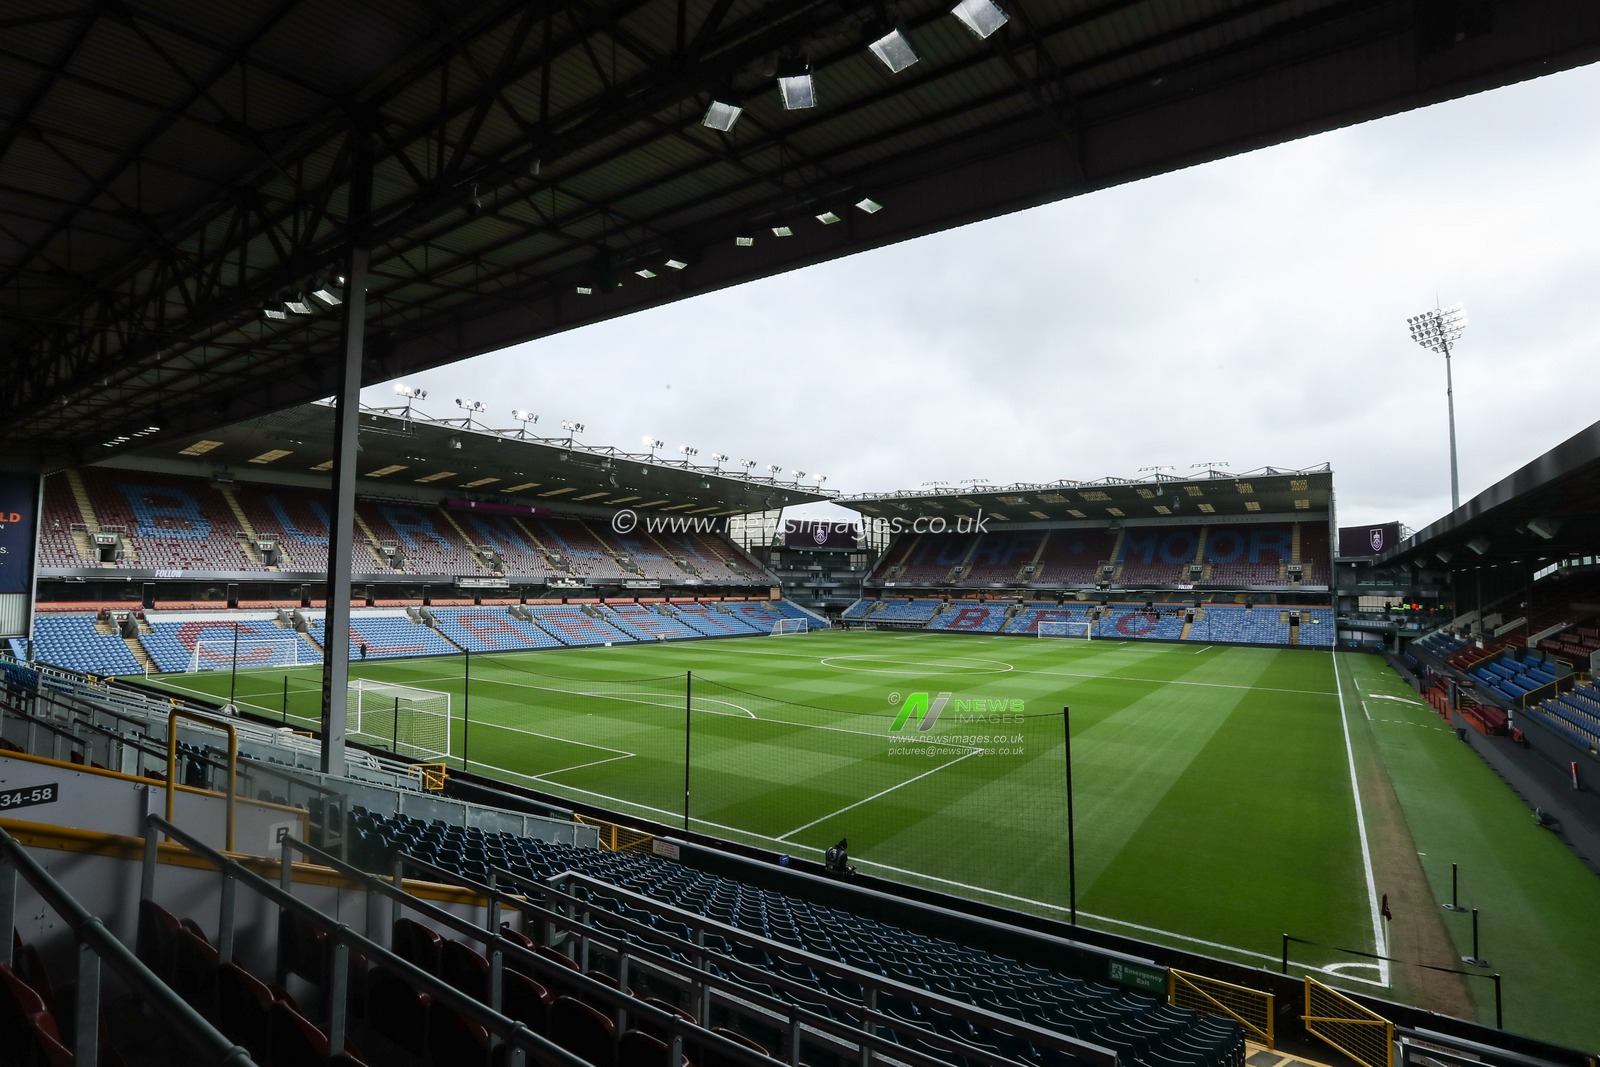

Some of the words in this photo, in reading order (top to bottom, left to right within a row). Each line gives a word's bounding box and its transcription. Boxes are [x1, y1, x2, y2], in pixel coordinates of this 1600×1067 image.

[1117, 528, 1293, 565] MOOR
[155, 570, 184, 578] FOLLOW
[0, 788, 52, 807] 34-58
[1123, 967, 1163, 982] Emergency
[1136, 977, 1150, 986] Exit
